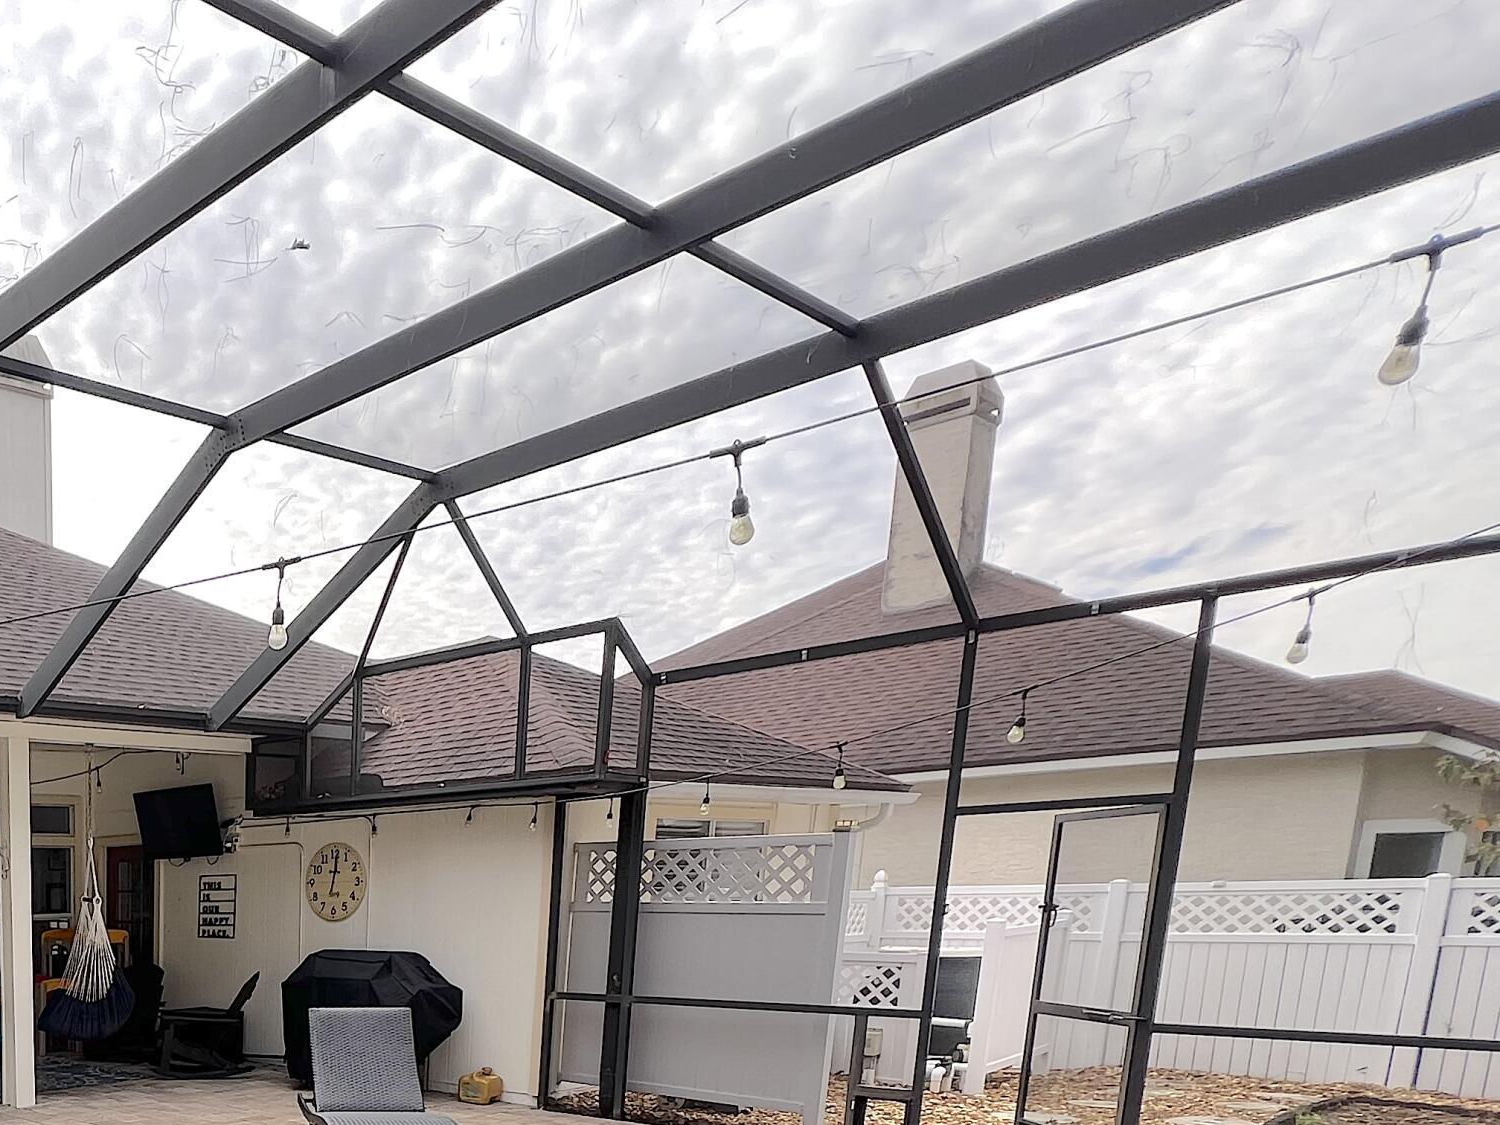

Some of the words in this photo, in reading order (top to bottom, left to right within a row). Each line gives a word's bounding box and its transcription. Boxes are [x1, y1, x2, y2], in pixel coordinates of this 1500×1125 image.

[321, 854, 328, 864] 11
[331, 849, 339, 859] 12
[344, 852, 348, 862] 1
[313, 865, 322, 874] 10
[352, 862, 357, 872] 2
[310, 878, 315, 888] 9
[354, 876, 360, 886] 3
[312, 892, 318, 901] 8
[350, 890, 355, 900] 4
[320, 902, 326, 911] 7
[331, 906, 336, 915] 6
[342, 902, 347, 911] 5
